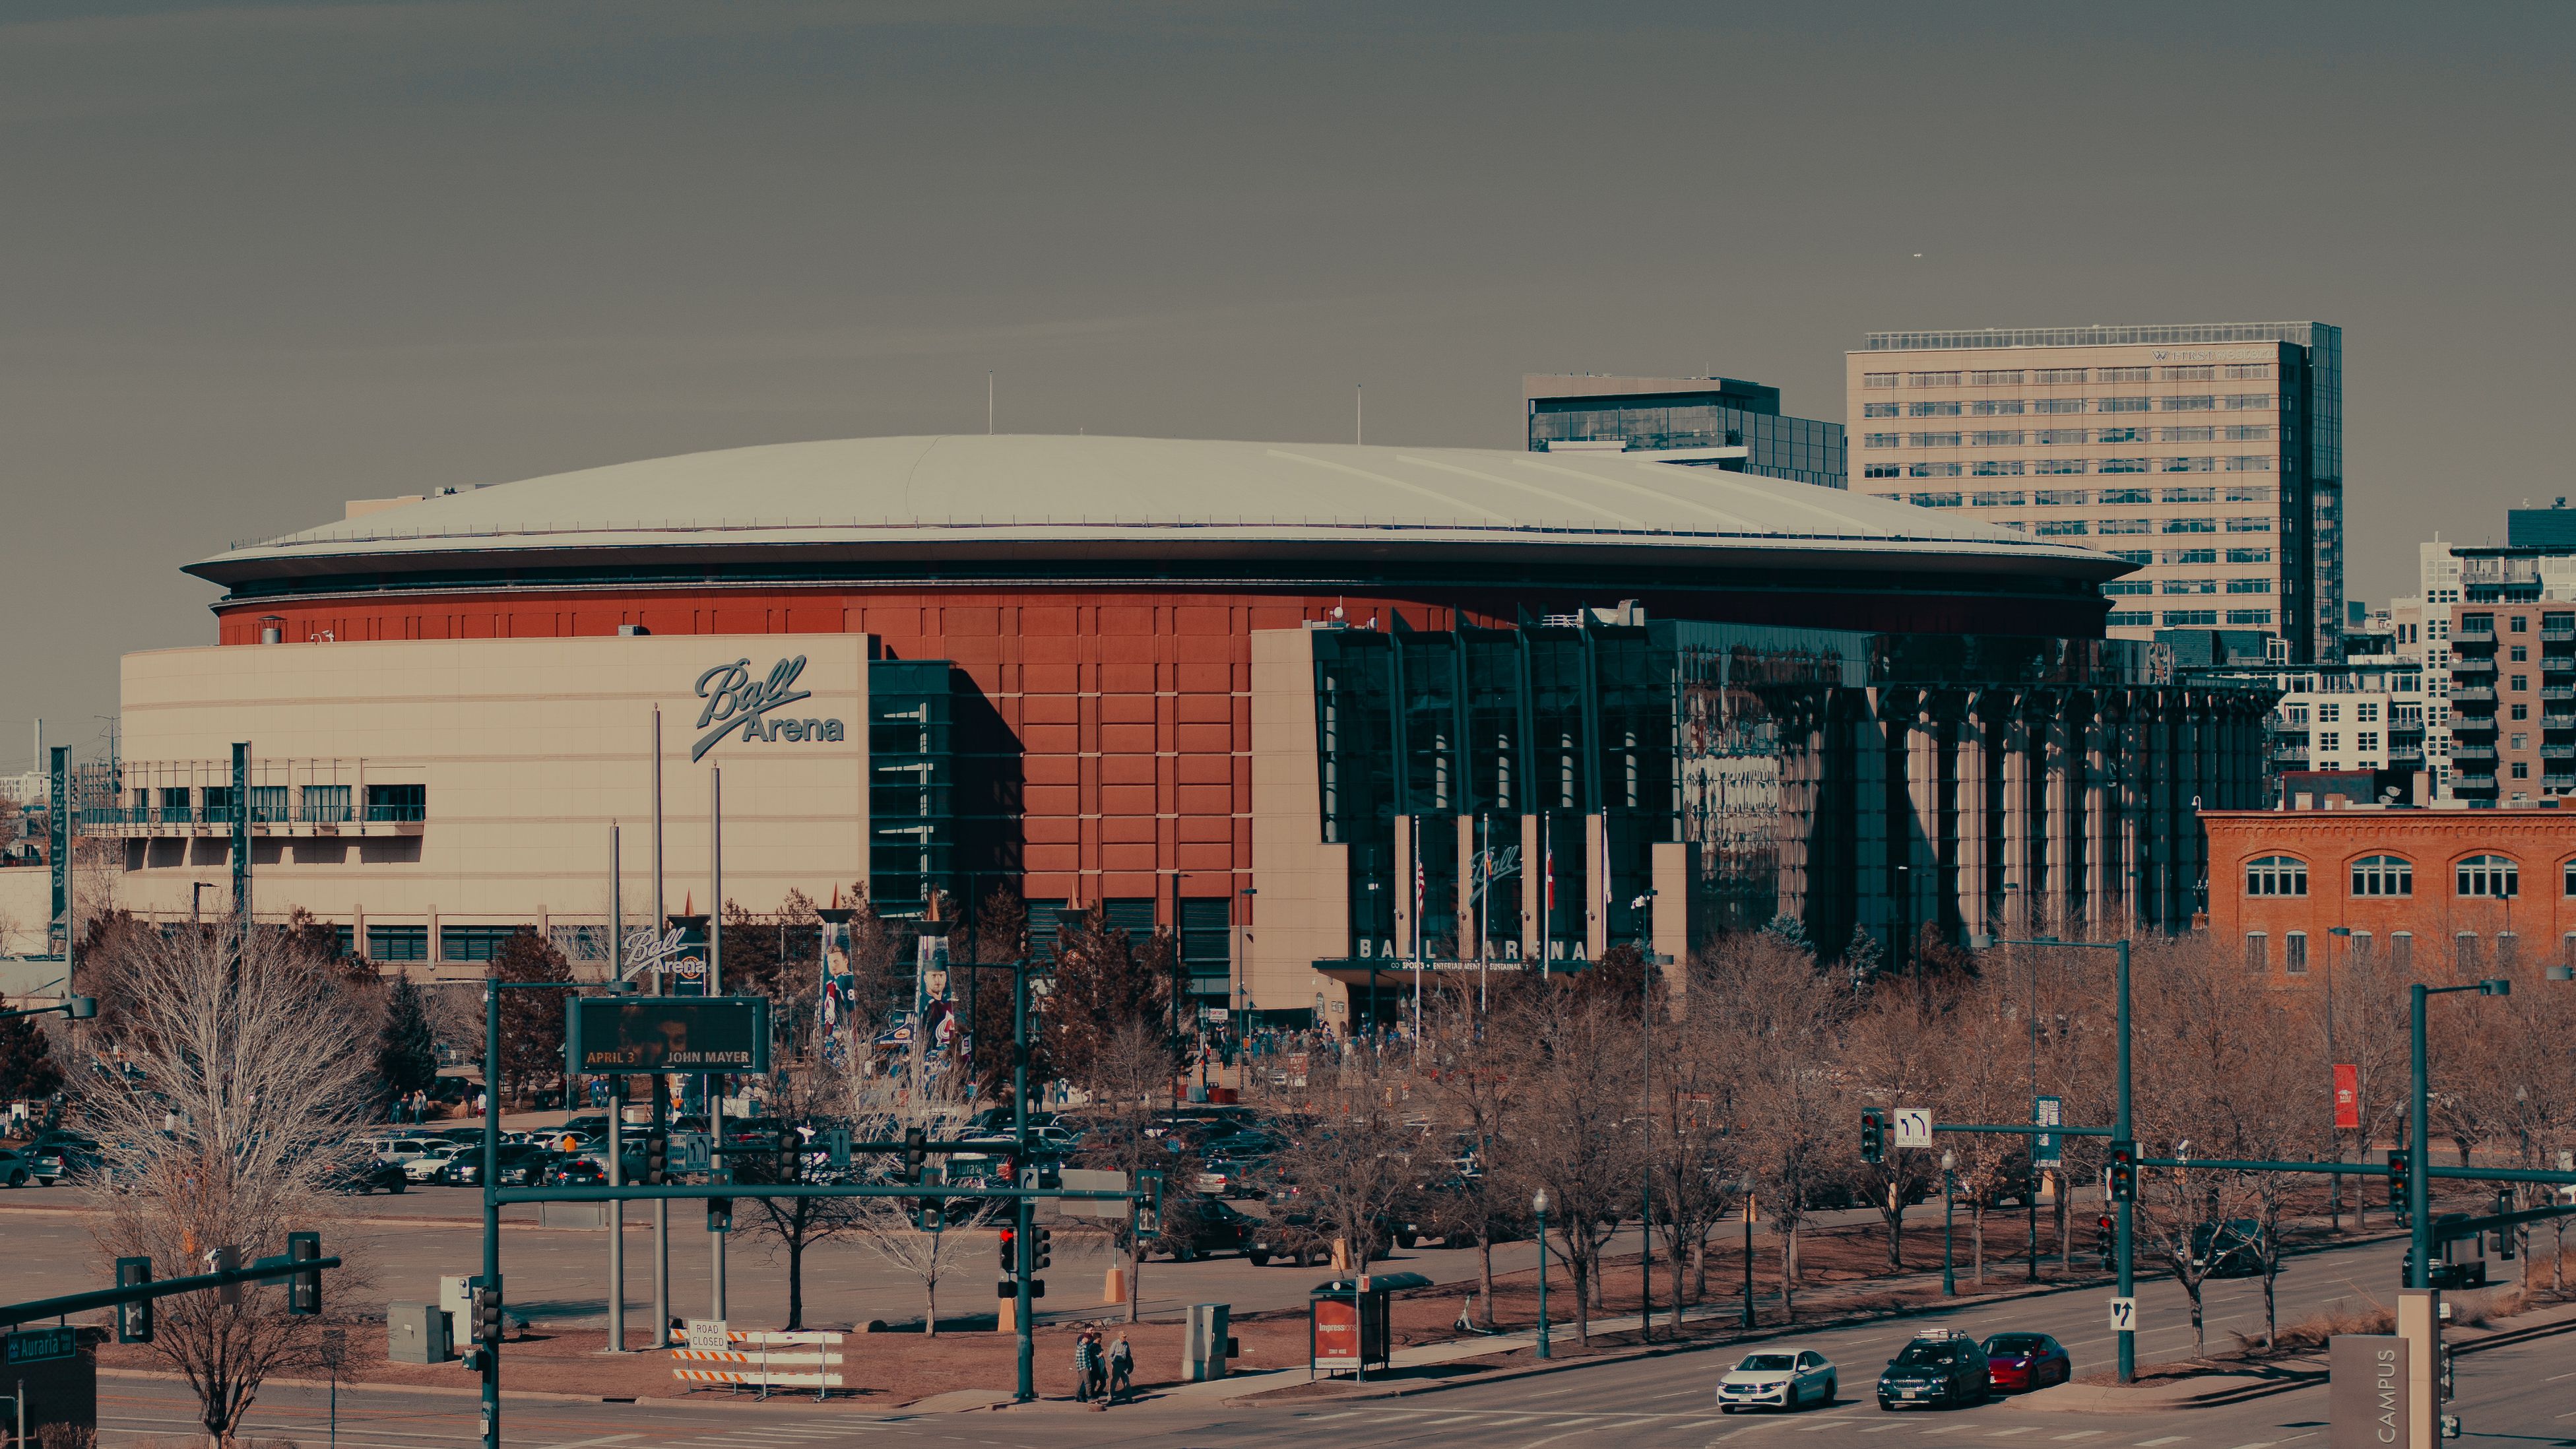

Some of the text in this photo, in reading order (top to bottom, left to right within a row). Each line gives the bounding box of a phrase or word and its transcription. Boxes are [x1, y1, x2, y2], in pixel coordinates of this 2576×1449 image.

[692, 654, 812, 763] Ball
[742, 713, 844, 742] Arena
[233, 765, 244, 827] ARENA
[52, 769, 64, 887] BALL ARENA
[622, 926, 688, 982] Ball
[1360, 939, 1586, 961] BALL ARENA
[650, 958, 707, 973] Arena
[587, 1051, 750, 1063] APRIL 3 JOHN MAYER
[697, 1324, 719, 1334] ROAD
[1319, 1322, 1357, 1334] Impressions
[22, 1334, 59, 1357] Auraria
[693, 1336, 724, 1347] CLOSED
[2378, 1349, 2397, 1444] CAMPUS
